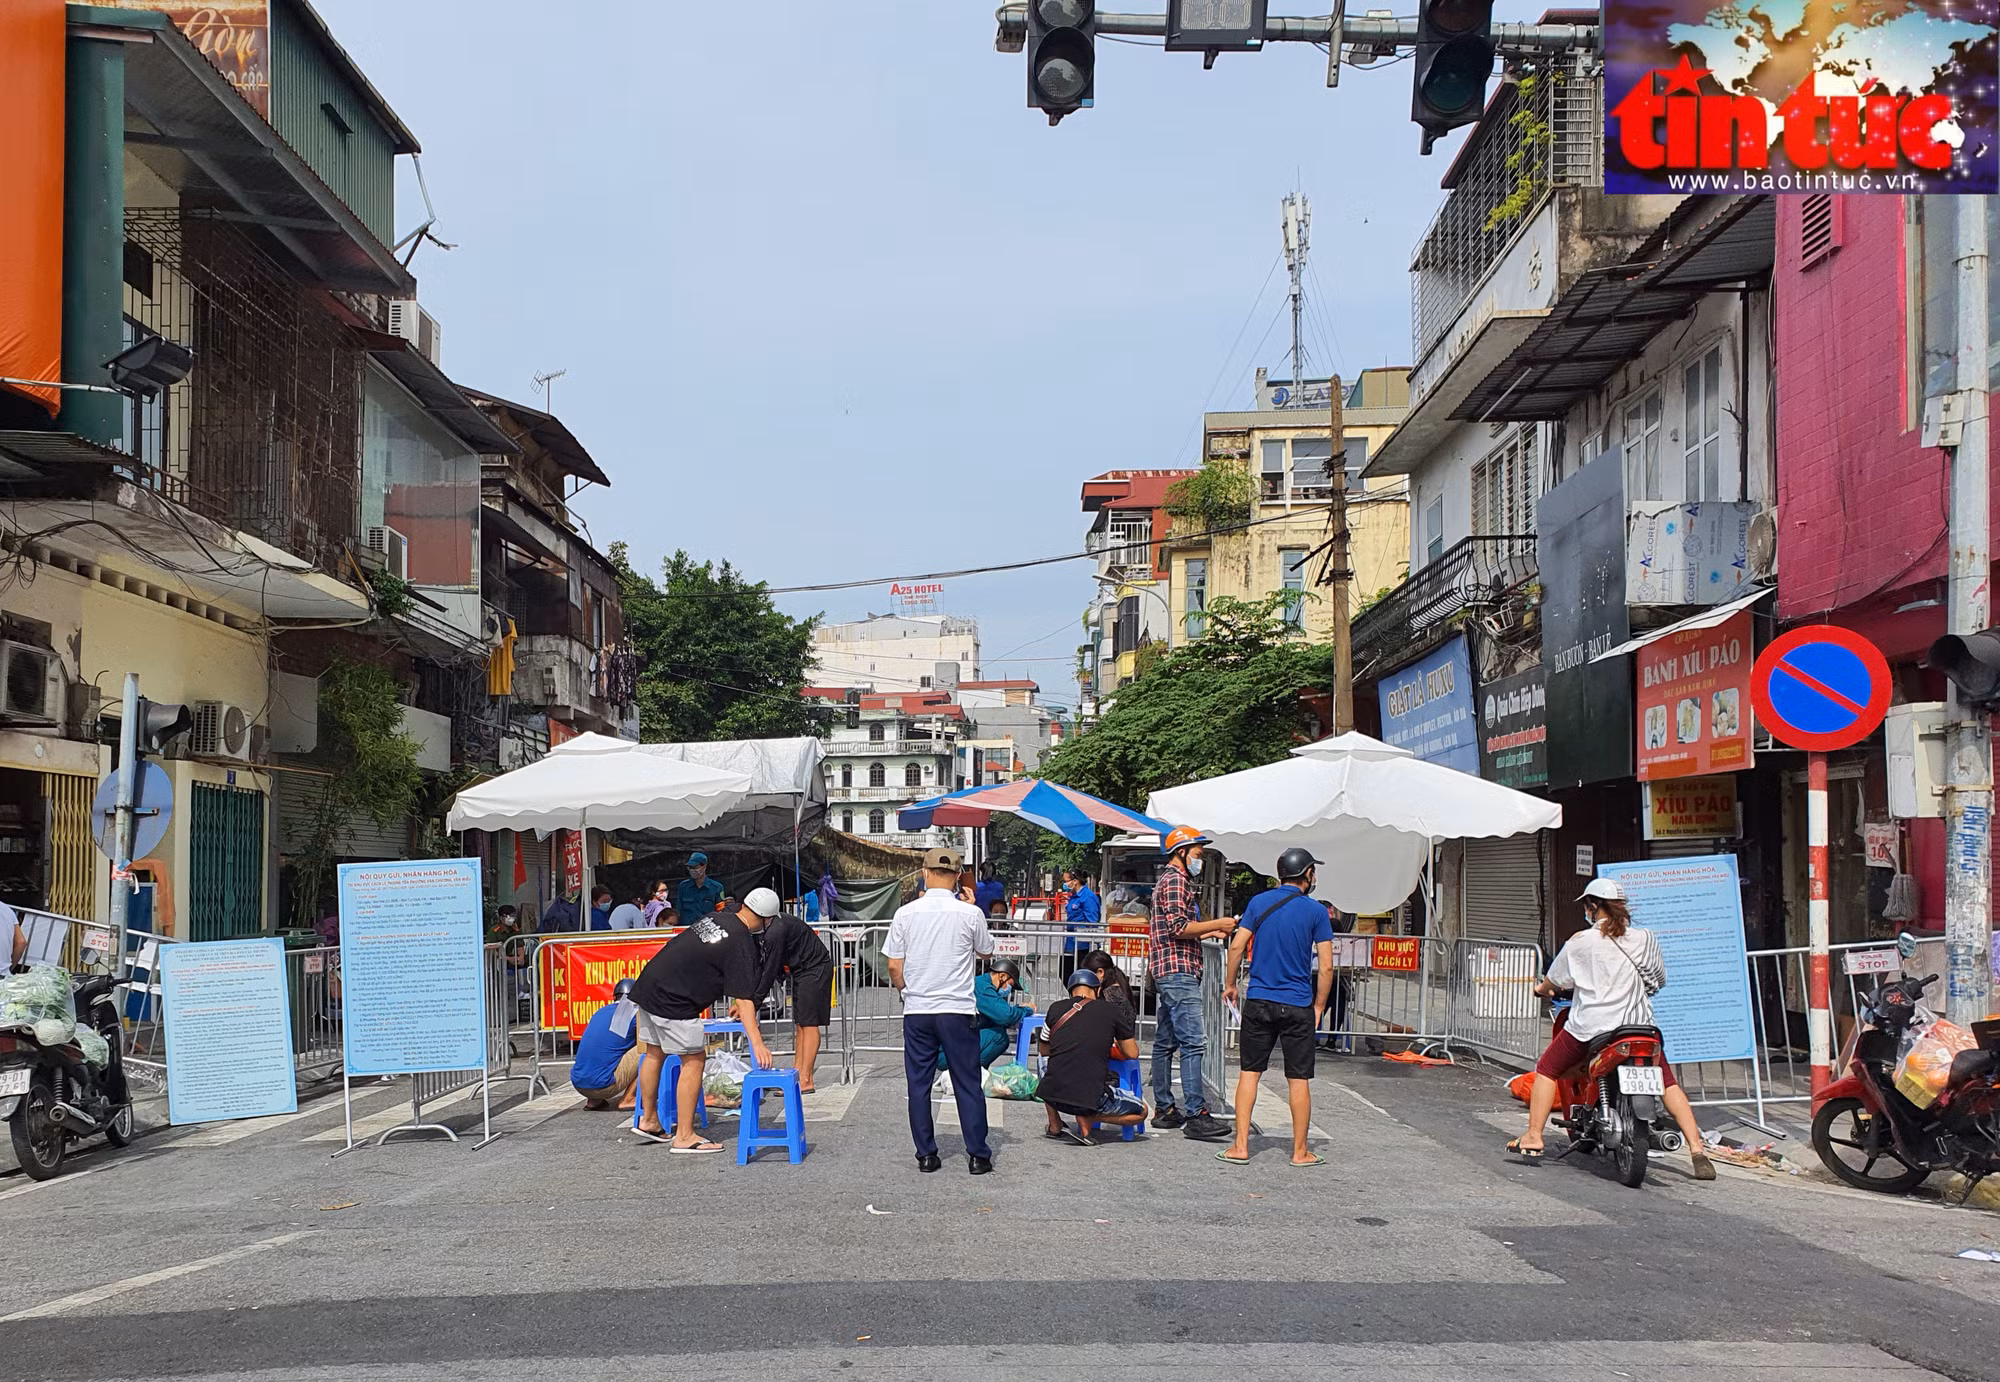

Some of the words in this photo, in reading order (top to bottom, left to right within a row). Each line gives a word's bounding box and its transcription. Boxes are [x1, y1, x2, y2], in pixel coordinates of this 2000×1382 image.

[890, 583, 912, 595] A25
[914, 584, 944, 594] HOTEL
[1644, 656, 1678, 688] BÁNH
[1682, 644, 1705, 677] XÍU
[1710, 634, 1740, 670] PÁO
[1656, 793, 1688, 814] XÍU
[1671, 815, 1693, 825] NAM
[403, 871, 423, 879] NHẬN
[424, 870, 442, 878] HÀNG
[1662, 870, 1681, 878] NHẬN
[1682, 868, 1701, 876] HÀNG
[90, 939, 108, 948] STO
[1378, 941, 1395, 951] KHU
[1397, 940, 1415, 954] VỰC
[1377, 955, 1400, 967] CÁCH
[1402, 957, 1413, 967] LY
[1858, 961, 1888, 969] STOP
[585, 962, 605, 985] KHU
[607, 958, 626, 983] VỰC
[1626, 1068, 1656, 1080] 29-C1
[1624, 1081, 1661, 1093] 398.44
